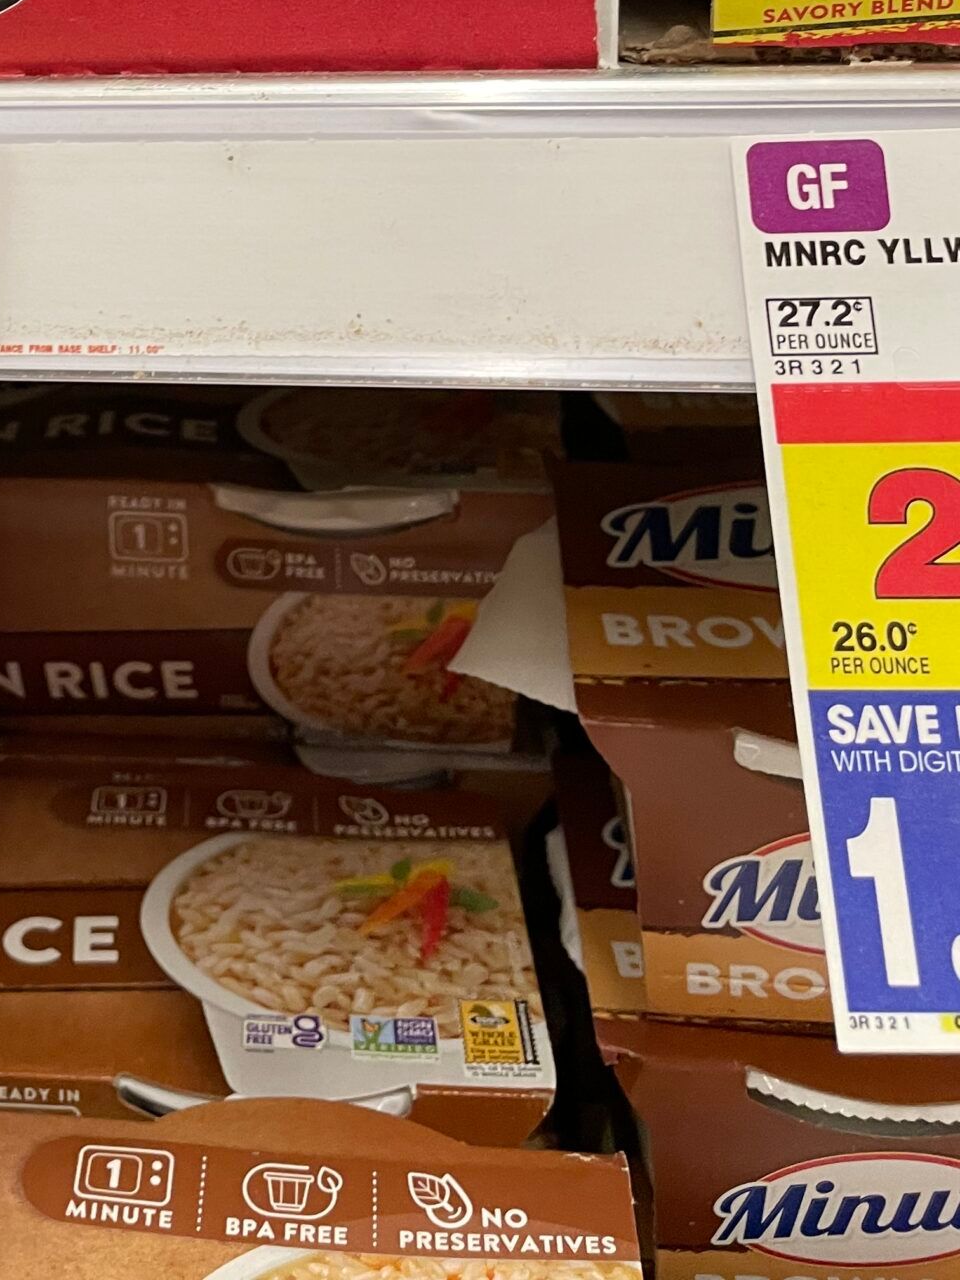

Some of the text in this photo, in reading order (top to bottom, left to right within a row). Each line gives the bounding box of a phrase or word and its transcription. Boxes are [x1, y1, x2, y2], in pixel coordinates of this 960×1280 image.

[763, 2, 864, 24] SAVORY
[786, 163, 849, 211] GF
[765, 239, 866, 268] MNRC
[776, 332, 875, 351] PER OUNCE
[774, 360, 804, 376] 3R
[43, 410, 219, 443] RICE
[109, 565, 190, 580] MINUTE
[830, 657, 931, 675] PER OUNCE
[43, 660, 201, 700] RICE
[827, 704, 942, 745] SAVE
[831, 750, 894, 774] WITH
[56, 1088, 82, 1104] IN
[105, 1158, 121, 1189] 1
[66, 1199, 349, 1246] MINUTE BPA FREE
[481, 1208, 529, 1229] NO
[398, 1230, 618, 1256] PRESERVATIVES
